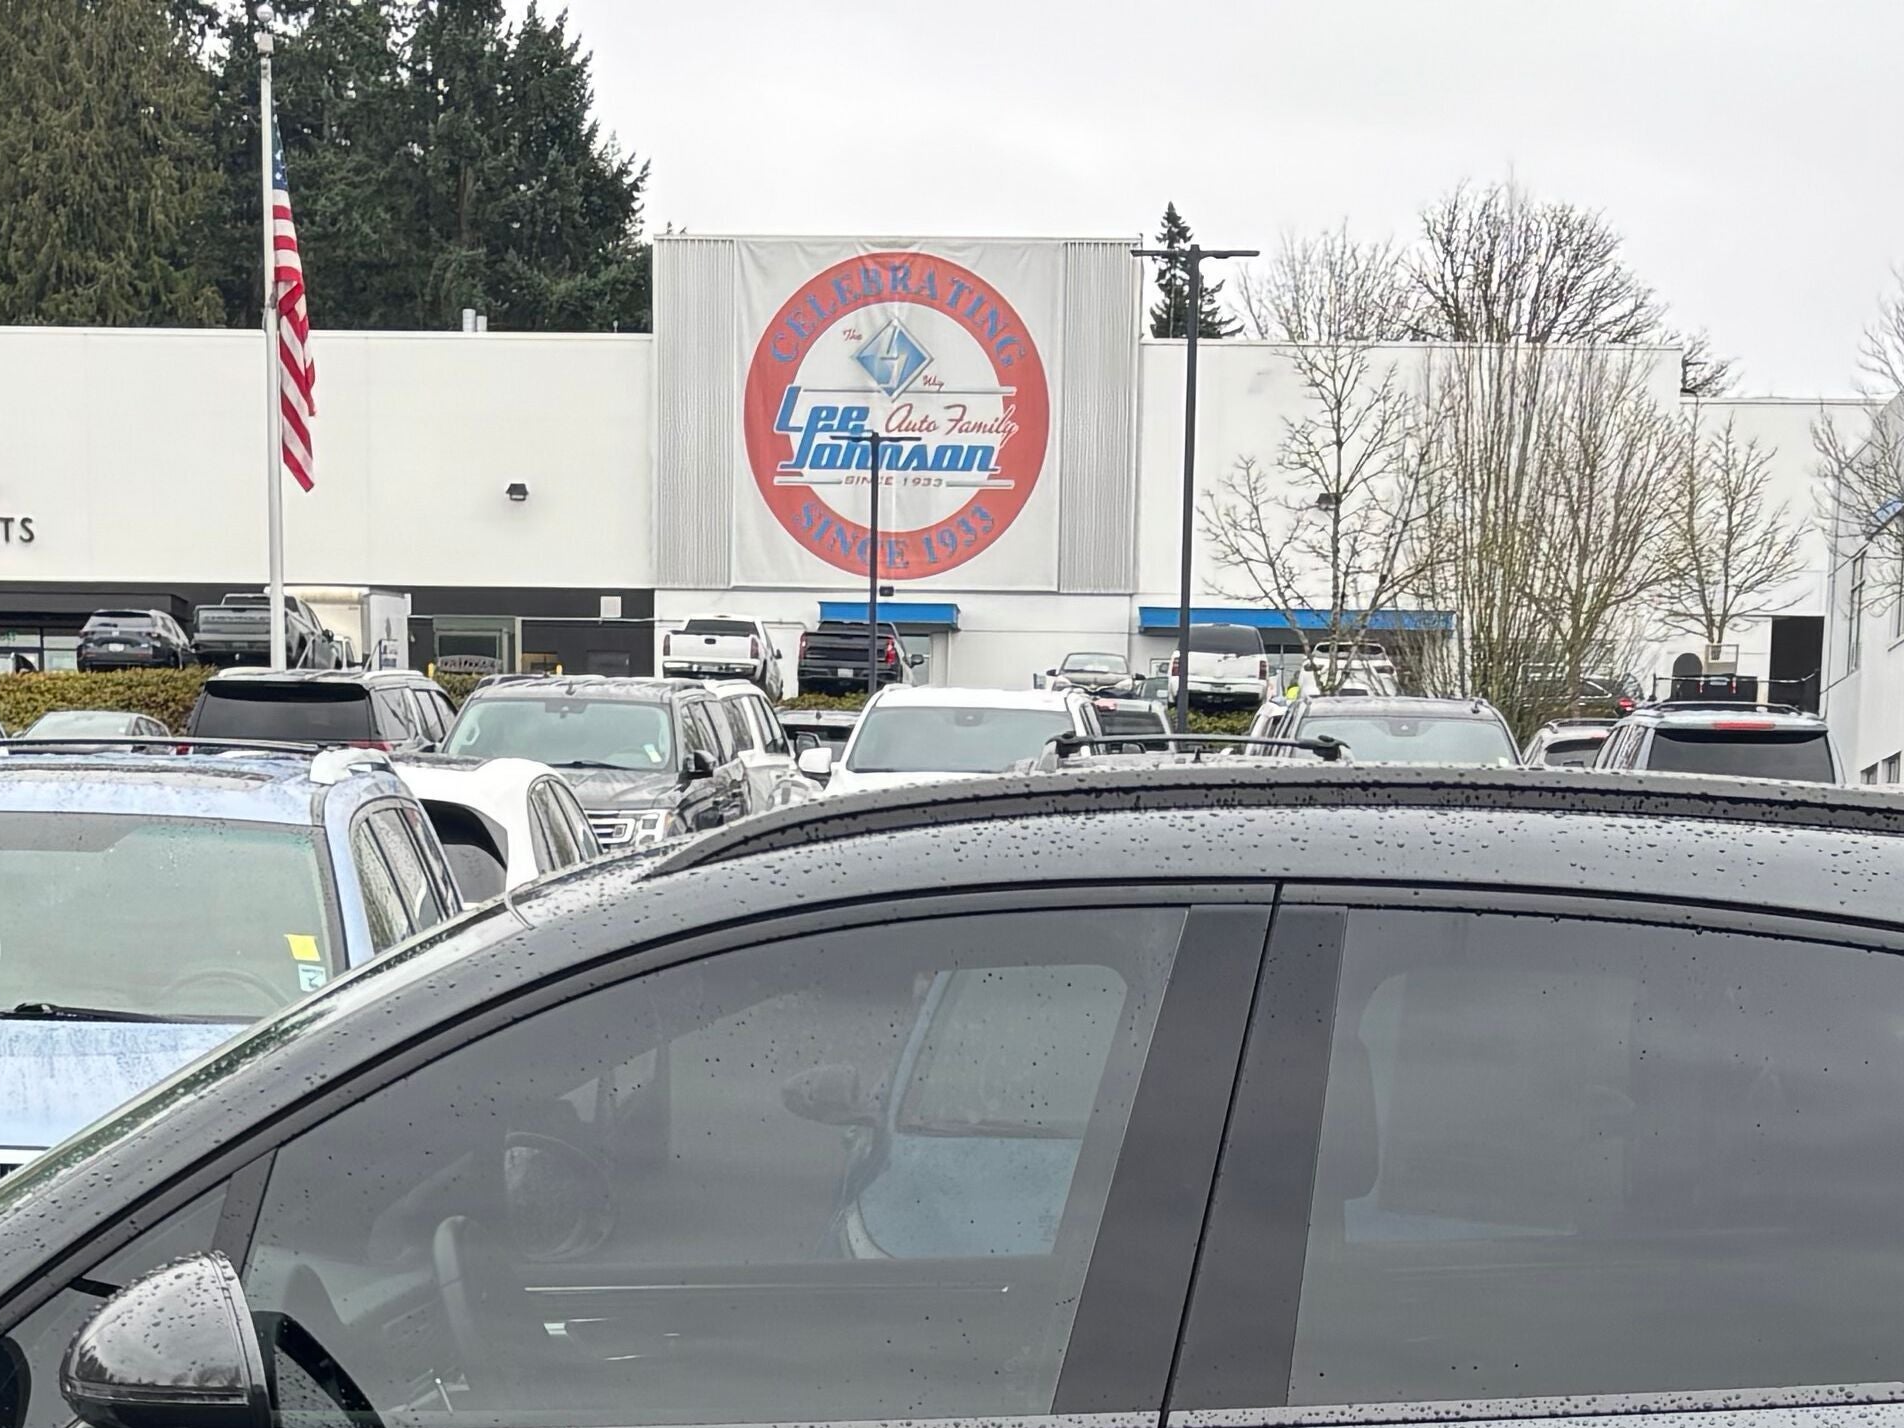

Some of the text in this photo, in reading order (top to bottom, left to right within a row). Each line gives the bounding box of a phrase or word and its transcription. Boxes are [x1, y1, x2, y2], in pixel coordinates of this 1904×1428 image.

[769, 261, 1026, 368] CELEBRATING
[774, 385, 1019, 448] Lee Auto Family
[921, 504, 995, 565] 1933
